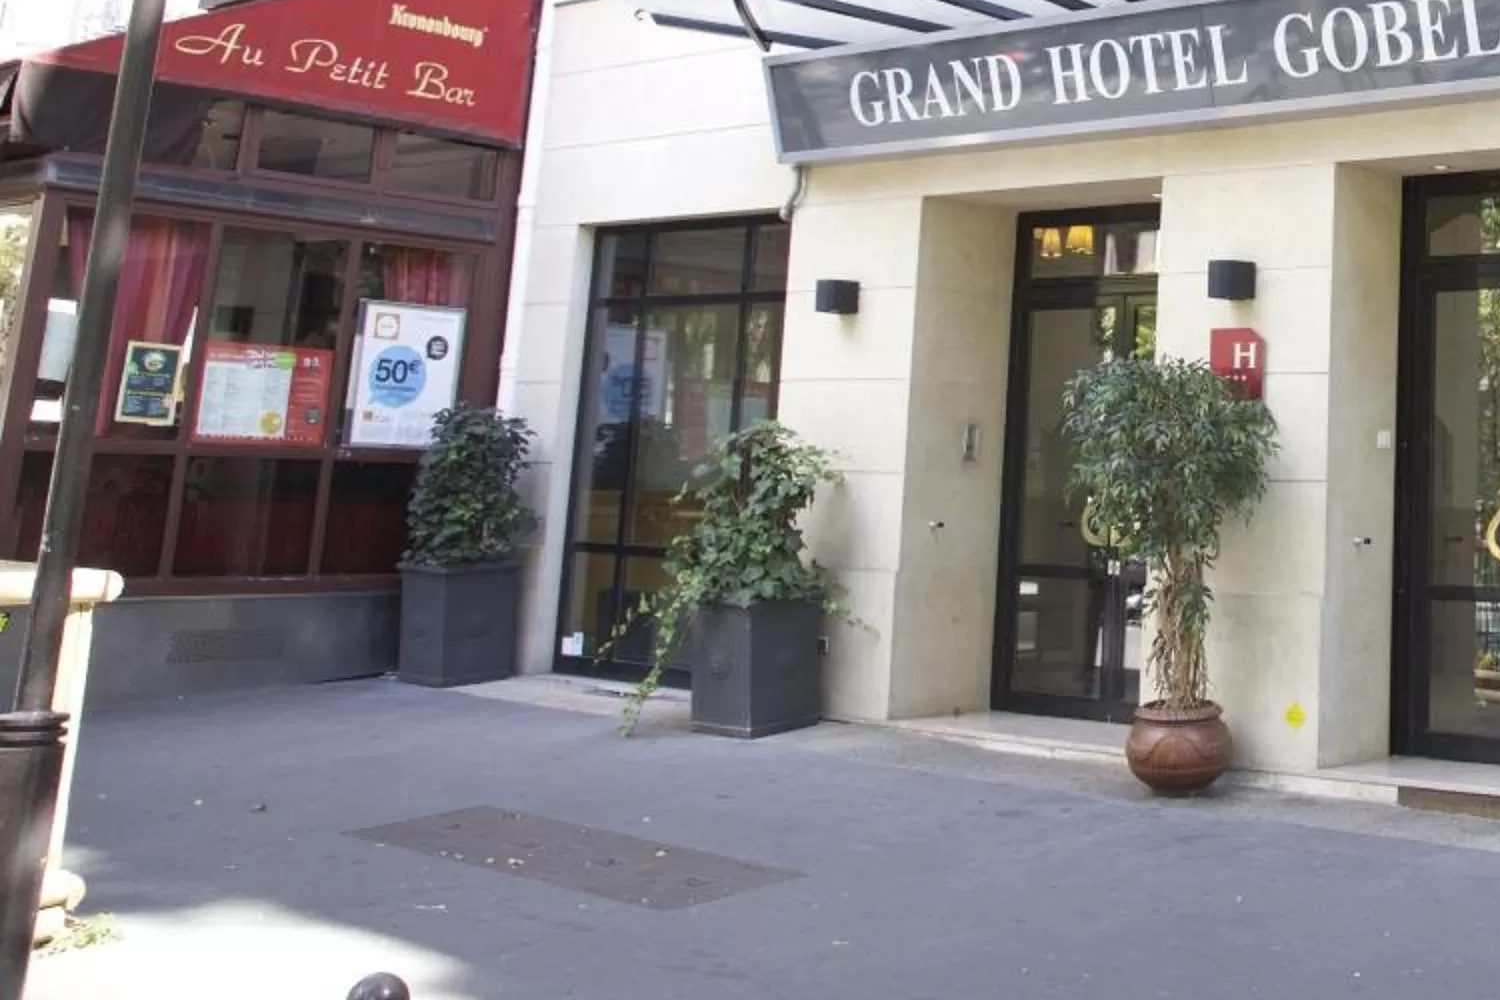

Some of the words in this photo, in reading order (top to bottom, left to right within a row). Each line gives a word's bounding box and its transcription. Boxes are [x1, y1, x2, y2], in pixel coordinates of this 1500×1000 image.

[388, 3, 486, 48] Kronenbourg
[175, 23, 264, 67] Au
[285, 39, 389, 89] Petit
[406, 61, 476, 107] Bar
[849, 53, 1021, 127] GRAND
[1046, 24, 1248, 105] HOTEL
[1232, 341, 1257, 369] H
